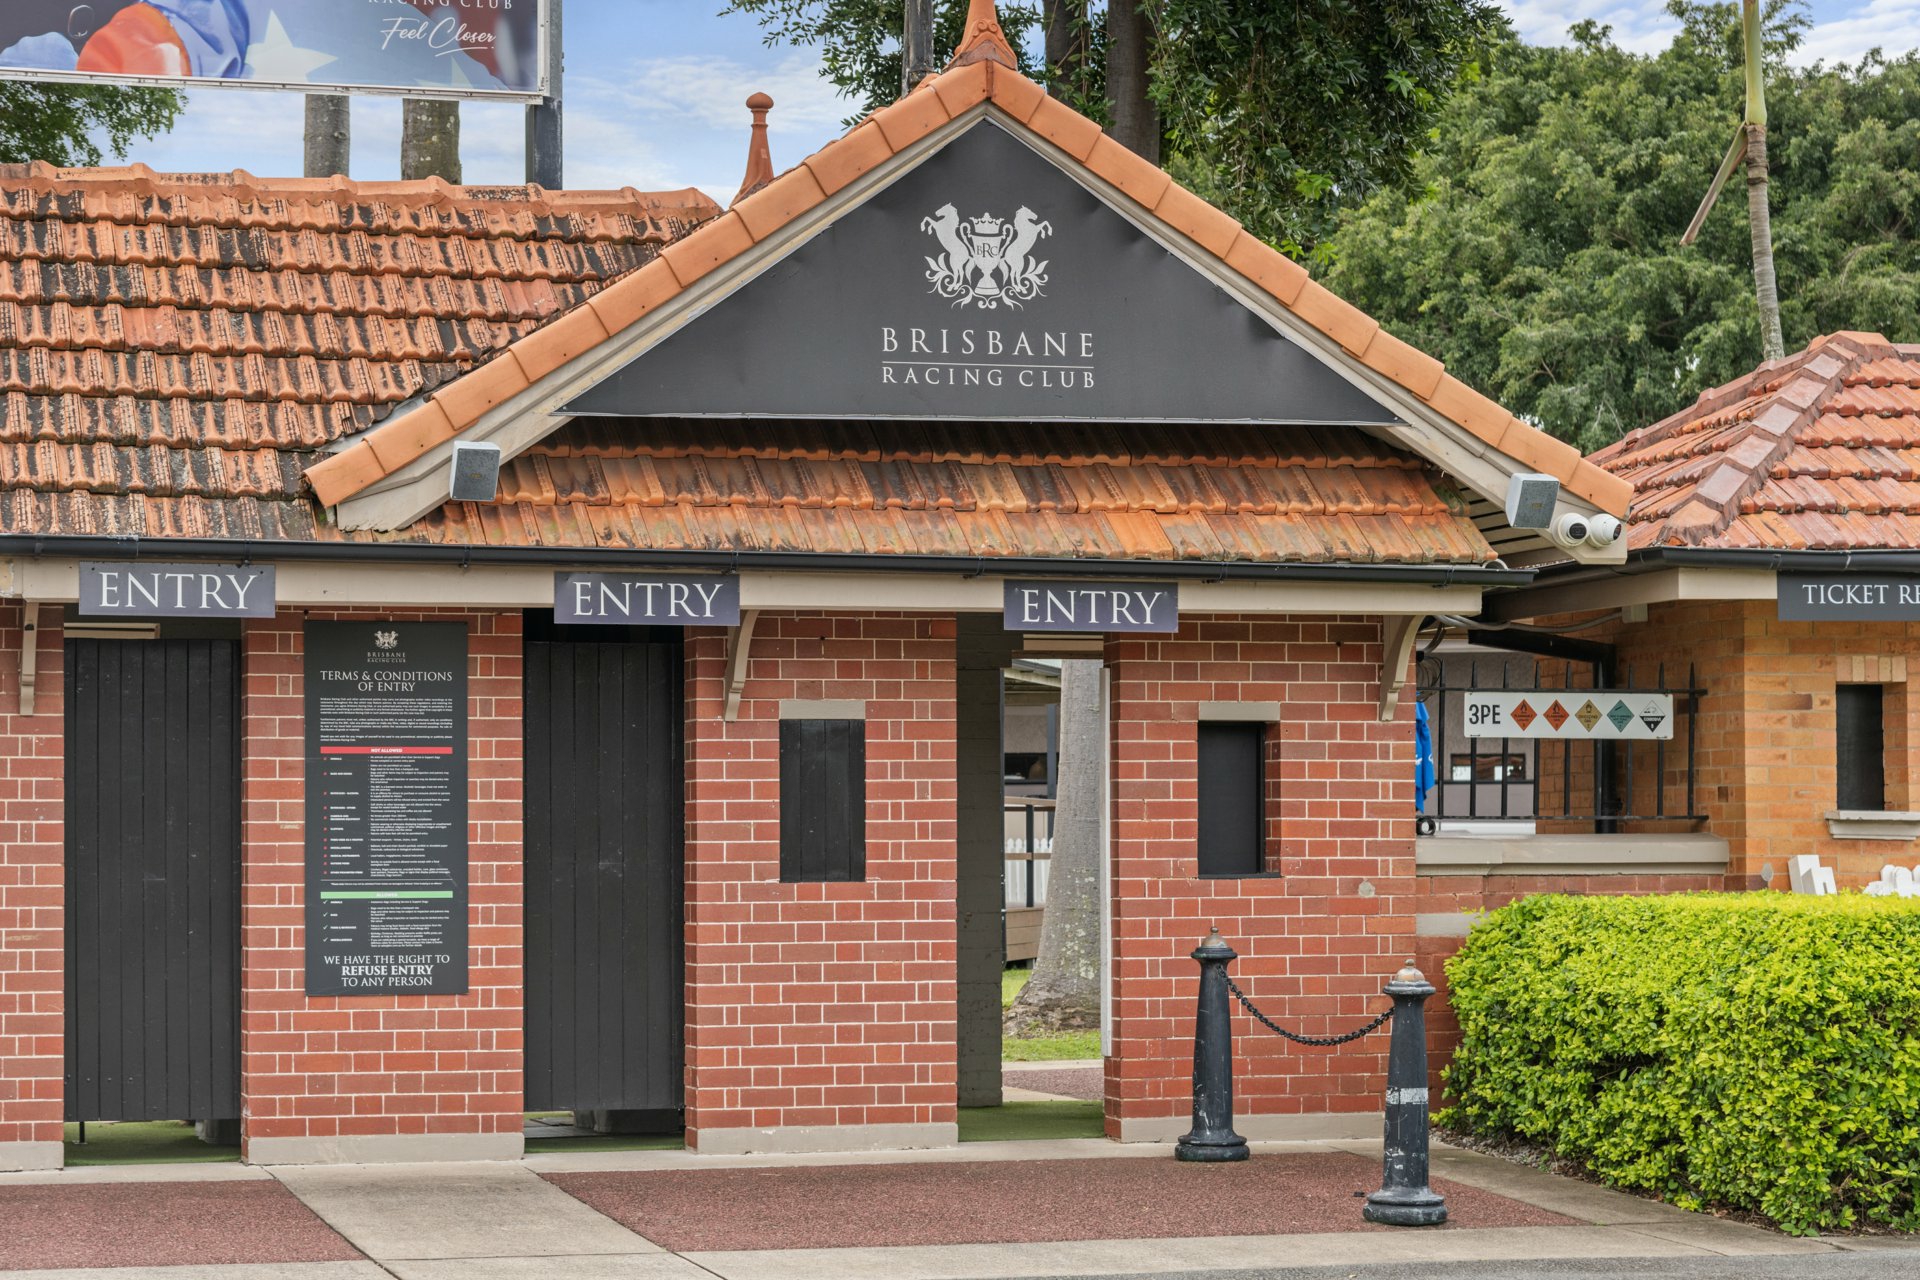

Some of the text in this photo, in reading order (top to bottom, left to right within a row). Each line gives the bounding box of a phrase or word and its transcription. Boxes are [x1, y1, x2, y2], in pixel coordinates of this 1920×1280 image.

[380, 17, 429, 51] Feel
[976, 242, 999, 258] BRC
[881, 327, 1094, 357] BRISBANE
[882, 366, 1095, 388] RACING CLUB
[99, 571, 257, 609] ENTRY
[573, 581, 724, 618] ENTRY
[1802, 584, 1889, 605] TICKET
[1021, 589, 1162, 625] ENTRY
[320, 670, 453, 682] TERMS & CONDITIONS
[358, 682, 416, 692] OF ENTRY
[1468, 703, 1501, 725] 3PE
[324, 954, 450, 965] WE HAVE THE RIGHT TO
[341, 965, 434, 976] REFUSE ENTRY
[341, 976, 433, 987] TO ANY PERSON
